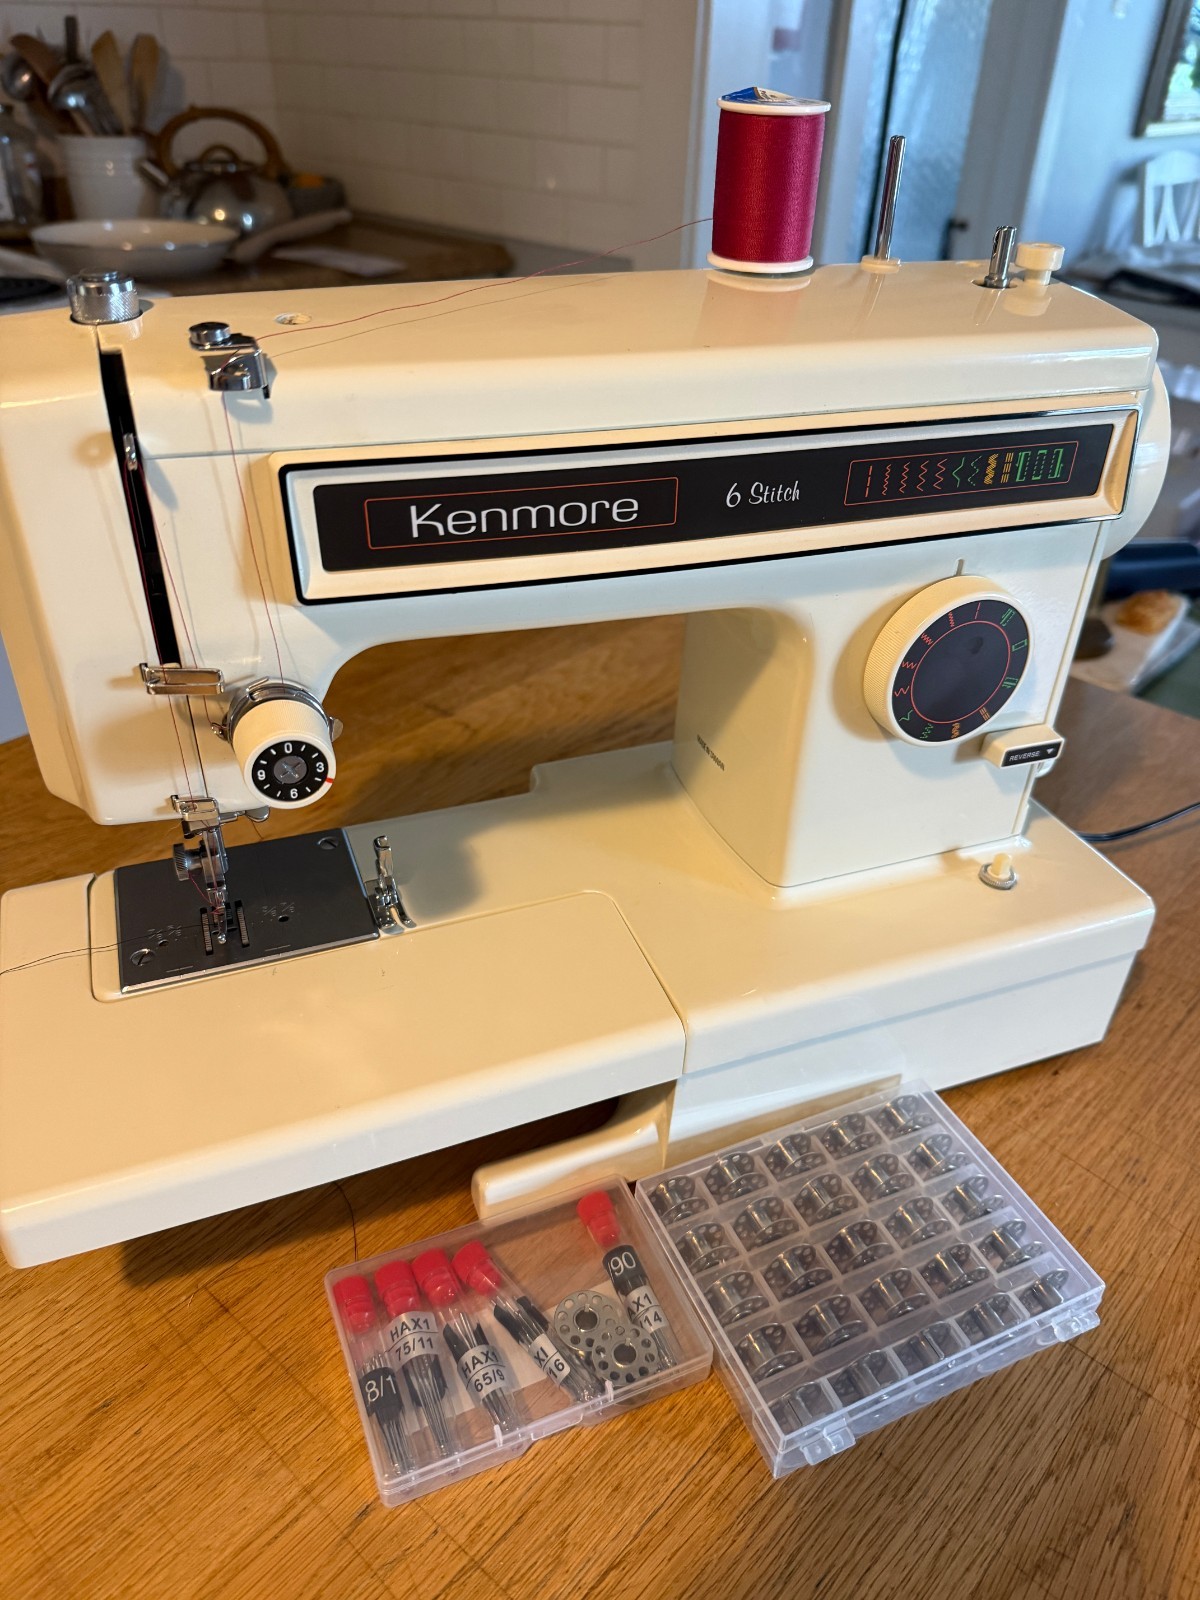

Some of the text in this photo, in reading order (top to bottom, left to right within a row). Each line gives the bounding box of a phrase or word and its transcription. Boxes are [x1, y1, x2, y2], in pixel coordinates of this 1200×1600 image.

[726, 480, 800, 508] 6 Stitch
[410, 498, 639, 538] Kenmore
[284, 742, 293, 754] 0
[1009, 751, 1040, 761] REVERSE
[257, 769, 266, 781] 9
[316, 761, 325, 773] 3
[290, 788, 298, 799] 6
[610, 1251, 636, 1276] 90
[390, 1318, 430, 1343] HAX1
[395, 1337, 434, 1362] 75/11
[461, 1350, 499, 1379] HAX1
[474, 1369, 505, 1393] 65/9
